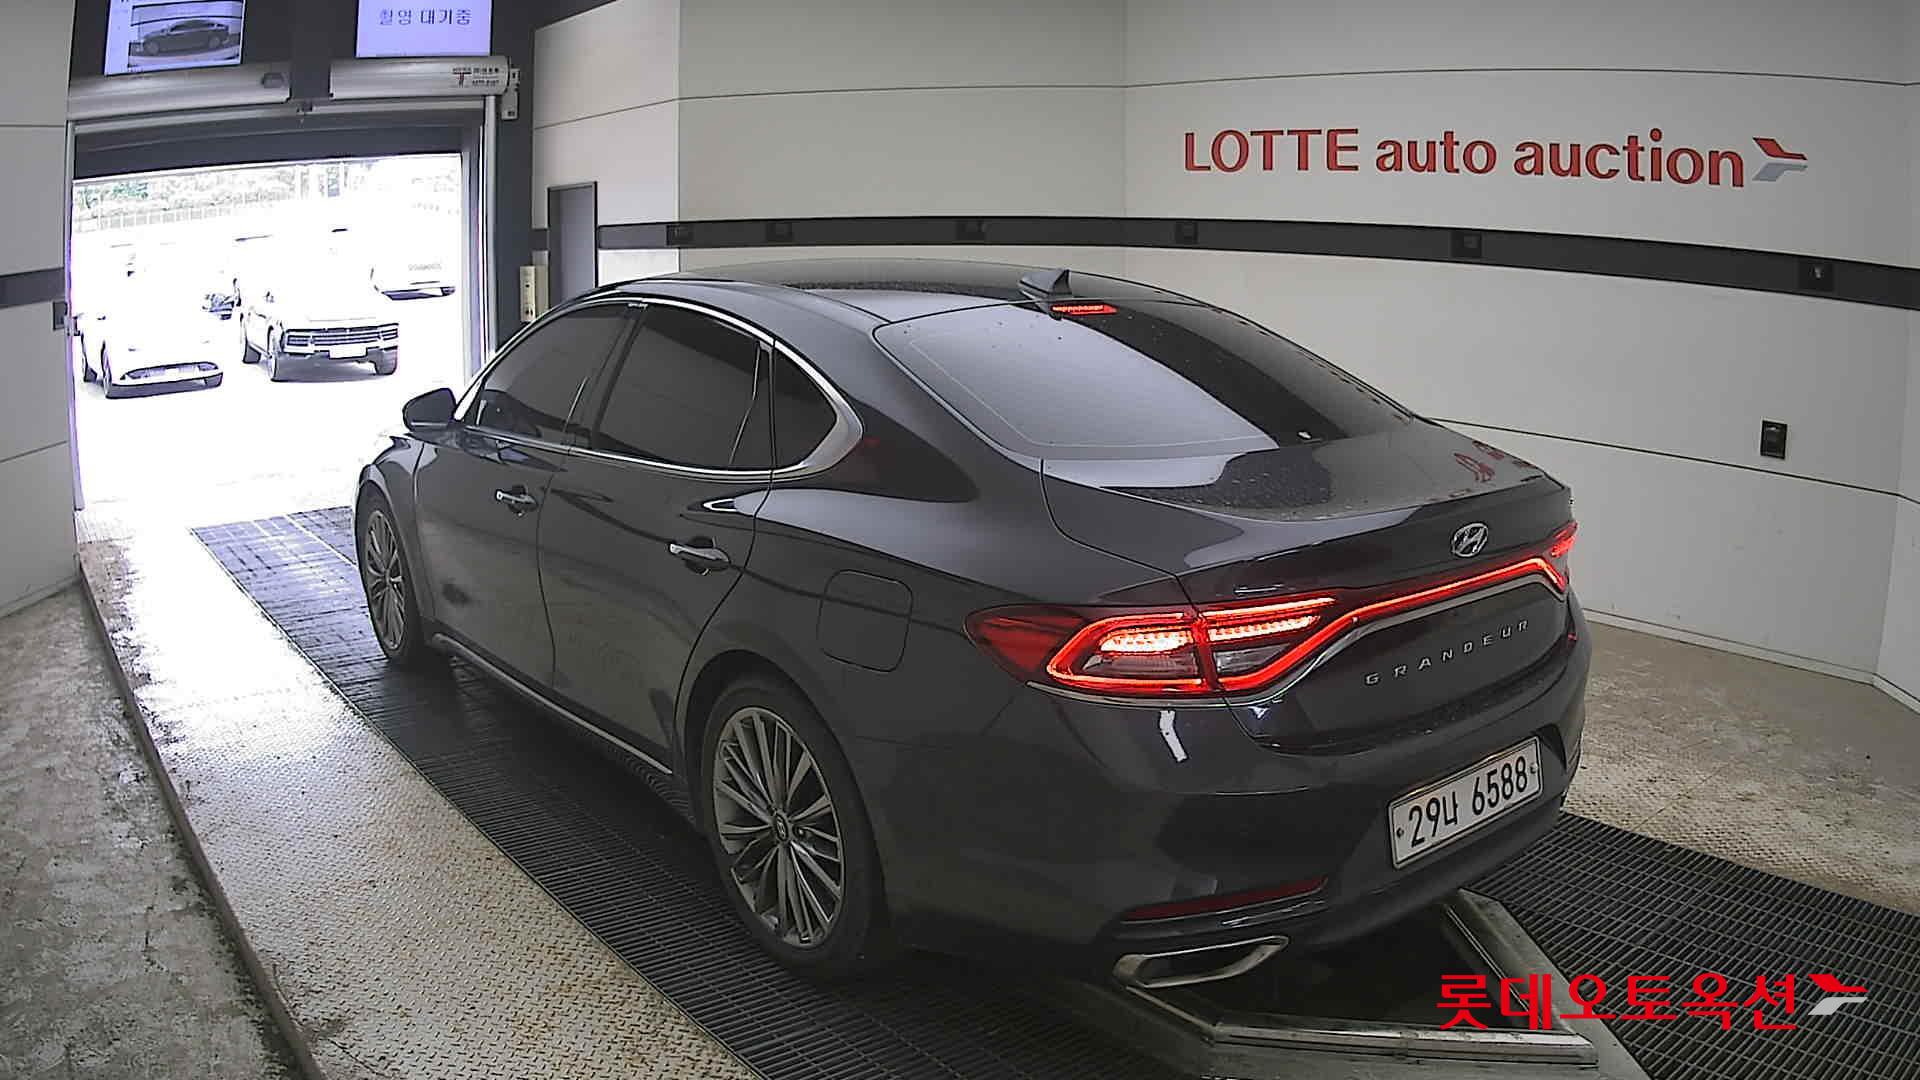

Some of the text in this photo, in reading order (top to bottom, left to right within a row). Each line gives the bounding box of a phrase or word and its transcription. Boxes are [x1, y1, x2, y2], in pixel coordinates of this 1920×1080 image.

[420, 8, 472, 26] 대기중
[1184, 128, 1745, 188] LOTTE auto auction
[1365, 620, 1529, 685] GRANDEUR
[1408, 756, 1528, 849] 29나 6588
